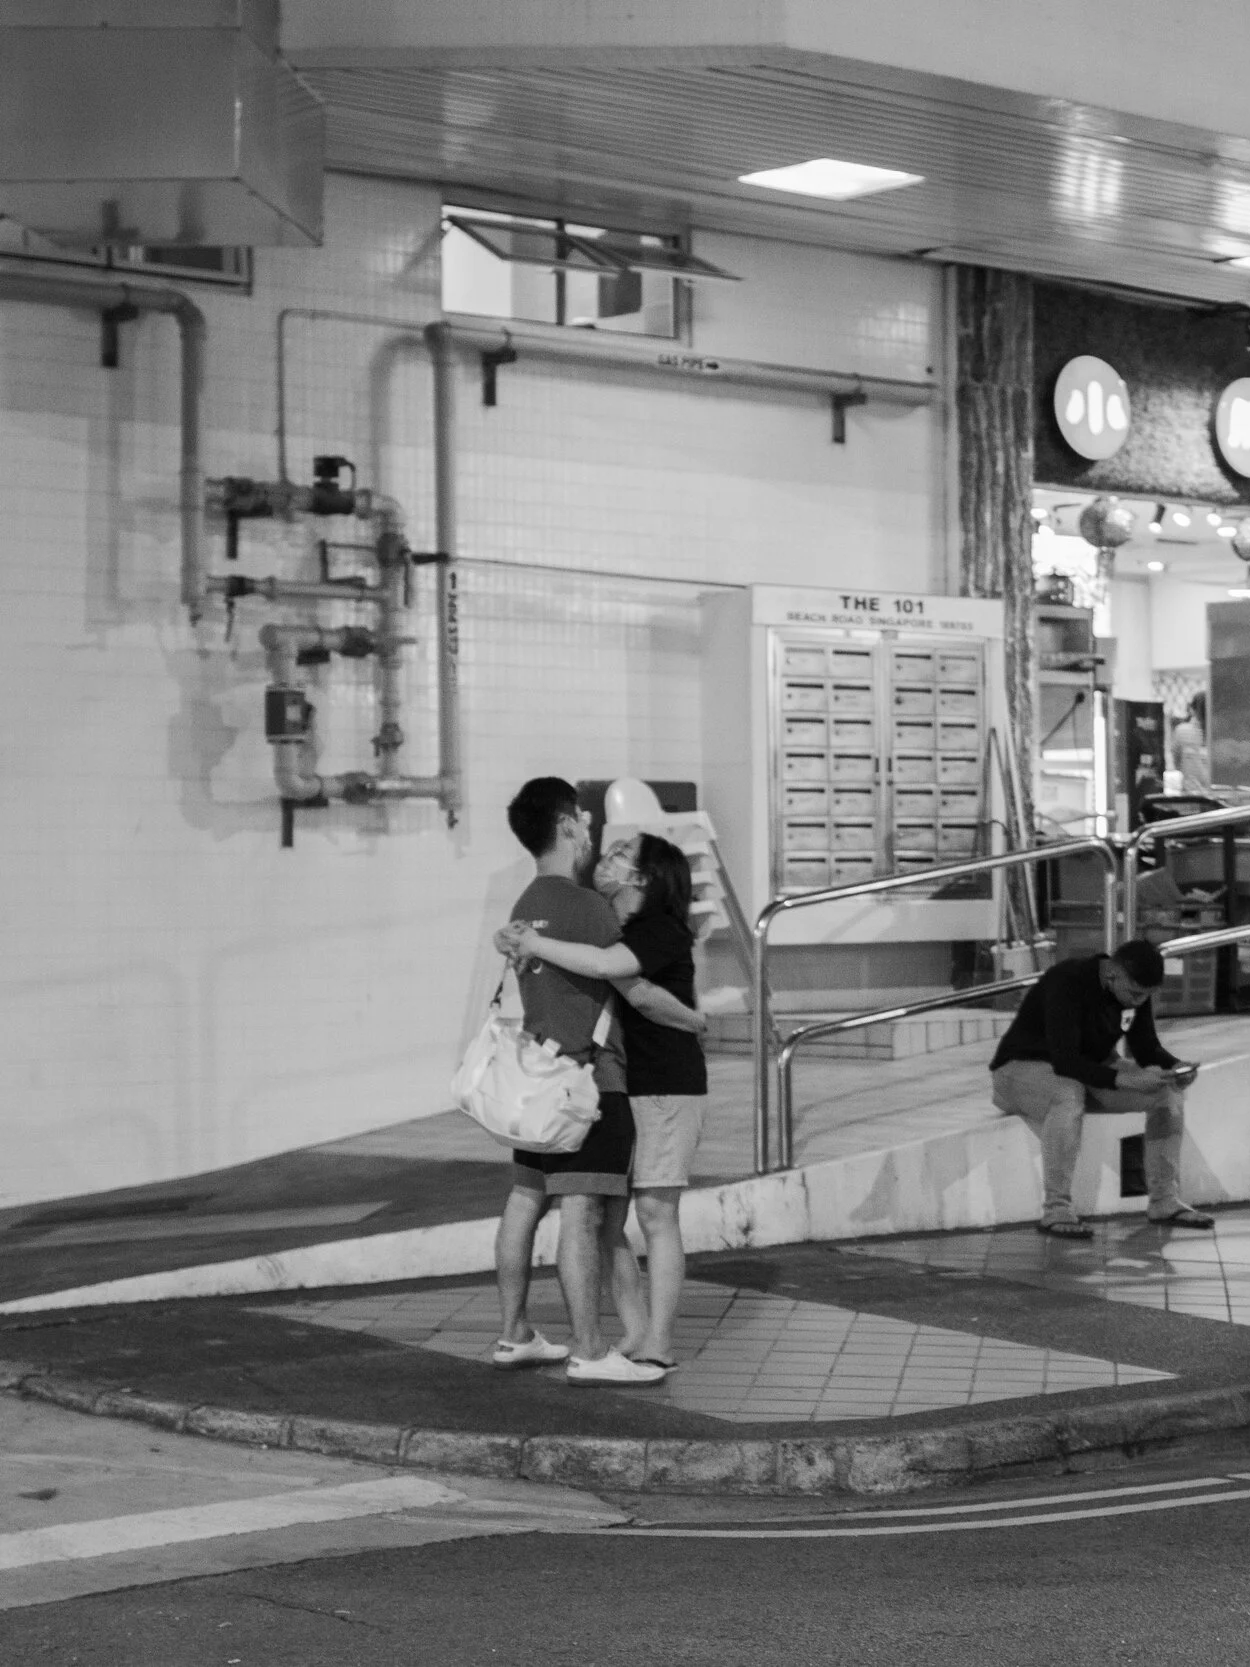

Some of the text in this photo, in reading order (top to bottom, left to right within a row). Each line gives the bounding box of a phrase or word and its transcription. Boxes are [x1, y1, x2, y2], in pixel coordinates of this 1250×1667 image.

[839, 595, 924, 614] THE 101
[786, 611, 826, 623] BEACH
[831, 613, 864, 625] ROAD
[869, 616, 933, 629] SINGAPORE
